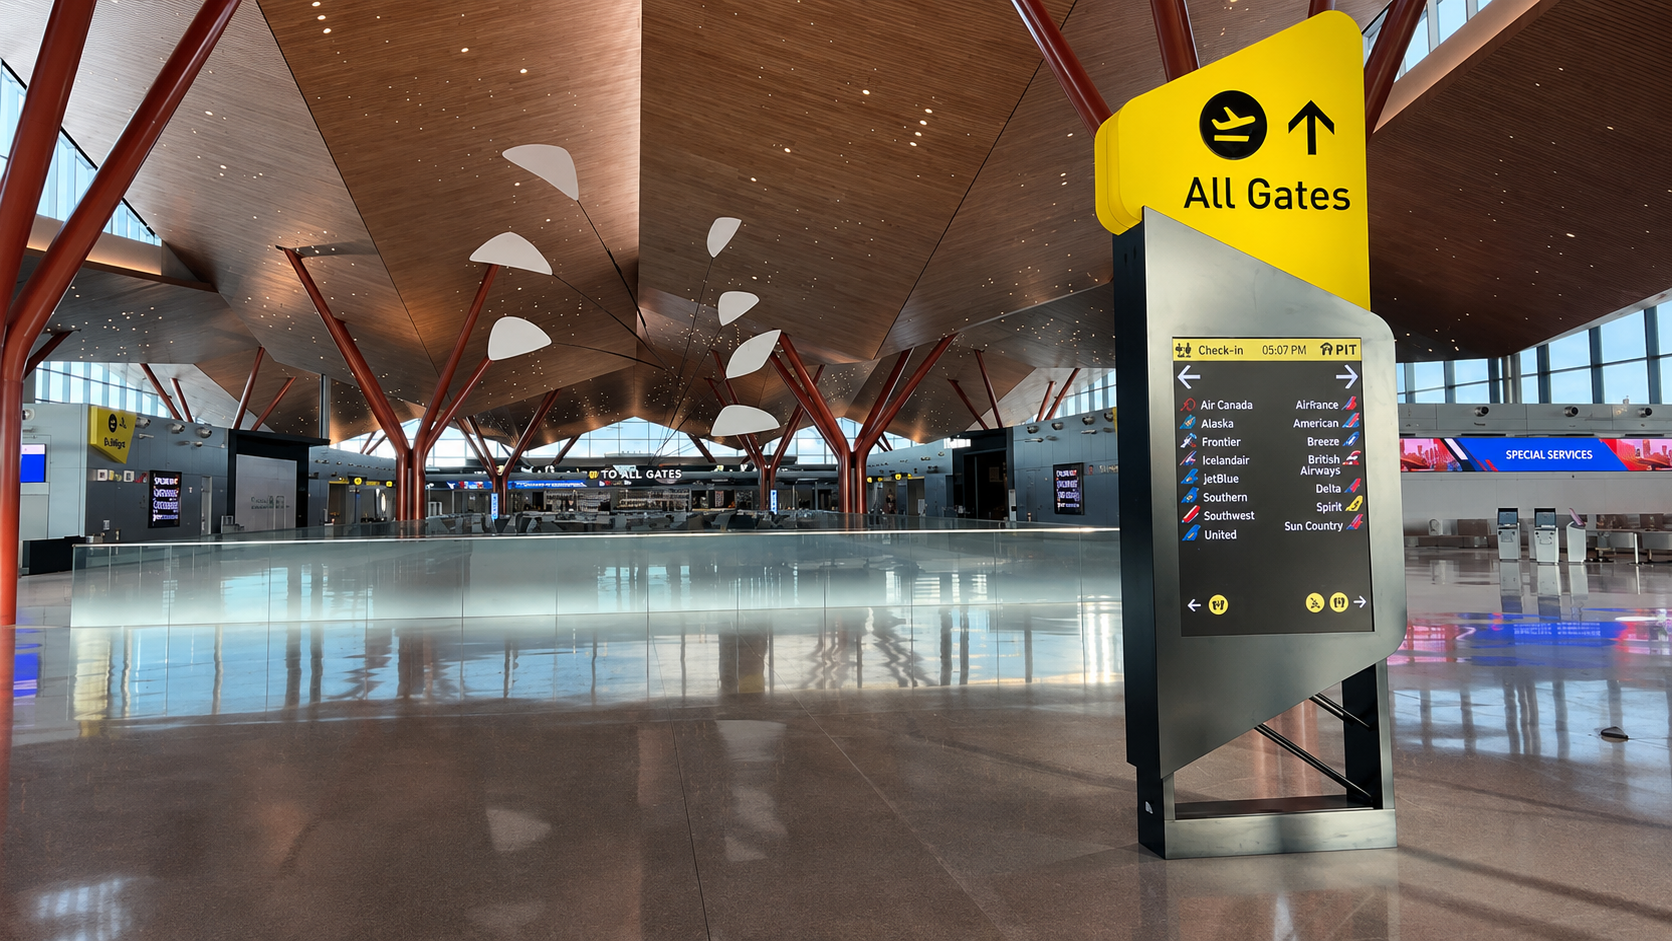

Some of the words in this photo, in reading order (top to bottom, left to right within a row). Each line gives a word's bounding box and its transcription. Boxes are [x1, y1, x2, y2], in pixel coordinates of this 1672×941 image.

[1184, 177, 1236, 209] All
[1248, 177, 1351, 211] Gates
[1198, 344, 1244, 356] Check-in
[1262, 344, 1288, 356] 05:07
[1291, 344, 1307, 355] PM
[1336, 344, 1357, 356] PIT
[1200, 398, 1216, 410] Air
[1218, 398, 1253, 410] Canada
[1201, 417, 1234, 429] Alaska
[1292, 417, 1339, 429] American
[1202, 436, 1242, 447] Frontier
[1307, 436, 1340, 447] Breeze
[1202, 454, 1250, 466] Icelandair
[1308, 454, 1341, 465] British
[1506, 450, 1545, 460] SPECIAL
[1548, 450, 1593, 460] SERVICES
[600, 469, 618, 480] TO
[621, 469, 643, 479] ALL
[646, 469, 682, 479] GATES
[1300, 465, 1341, 478] Airways
[1203, 473, 1240, 486] jetBlue
[1315, 483, 1342, 494] Delta
[1203, 491, 1248, 503] Southern
[1316, 501, 1343, 514] Spirit
[1203, 510, 1256, 522] Southwest
[1284, 521, 1303, 532] Sun
[1305, 520, 1344, 533] Country
[1204, 528, 1238, 541] United
